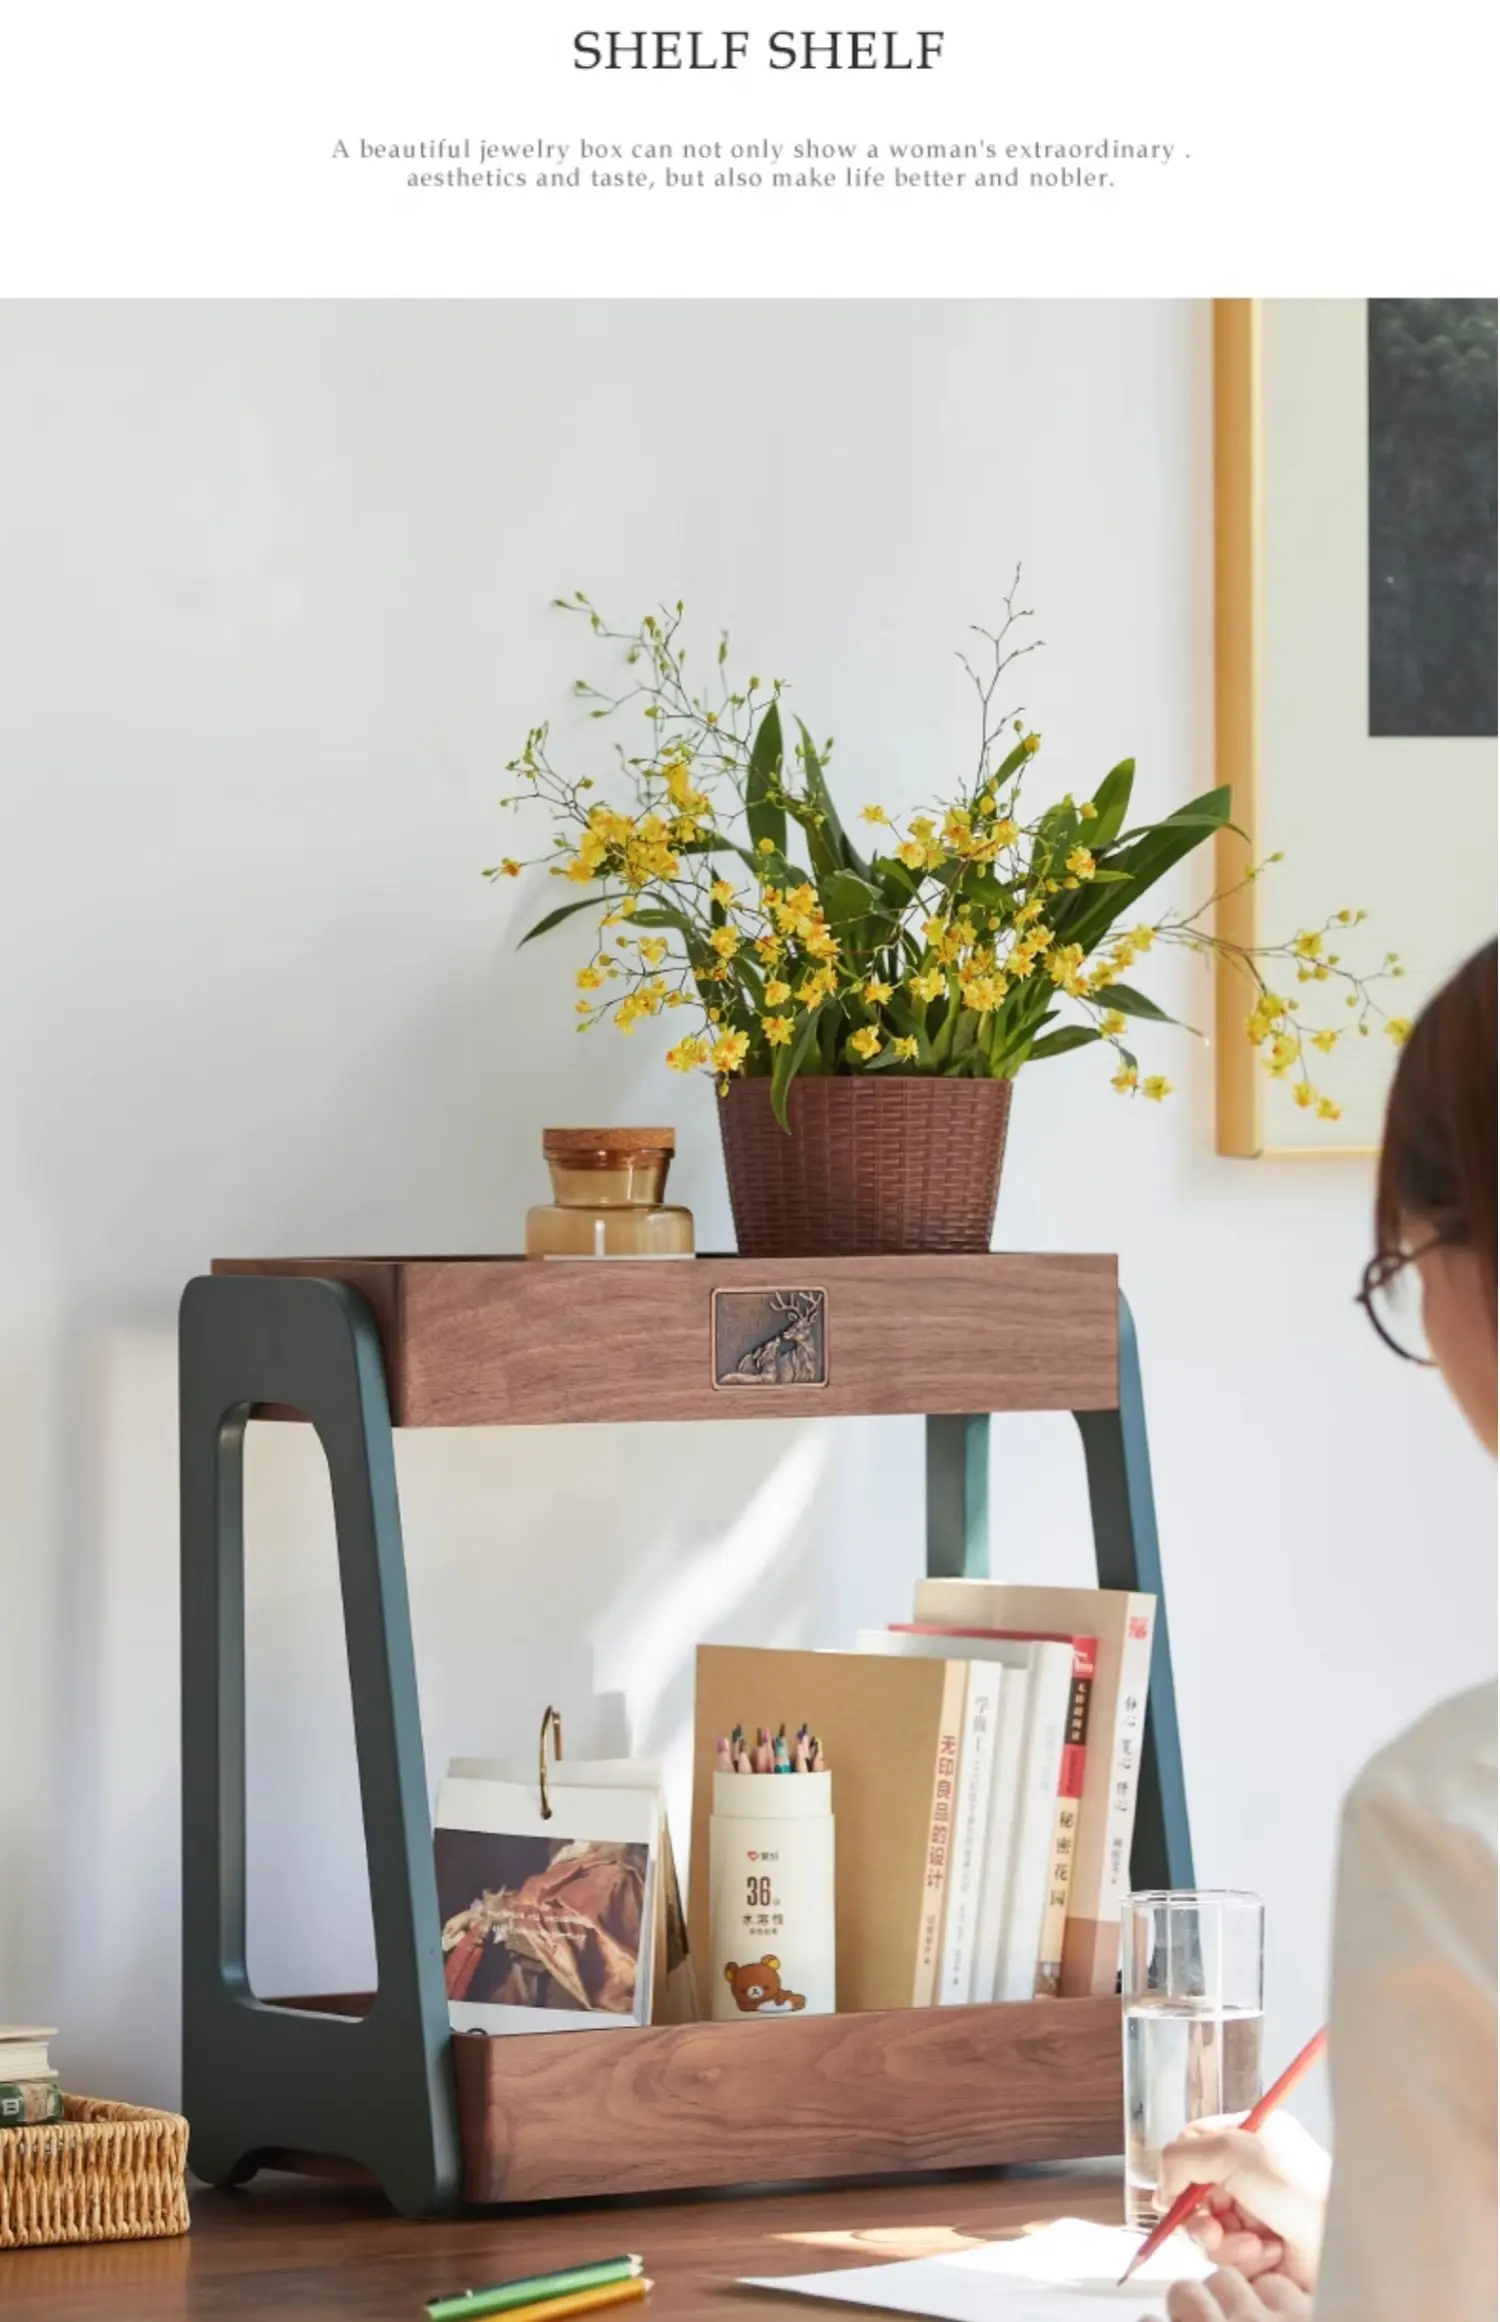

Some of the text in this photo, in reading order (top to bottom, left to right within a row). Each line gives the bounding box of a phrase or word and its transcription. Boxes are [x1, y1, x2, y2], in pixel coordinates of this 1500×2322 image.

[926, 1735, 957, 1891] 无印良品的设计
[1050, 1811, 1075, 1907] 秘密花园
[746, 1876, 771, 1906] 36
